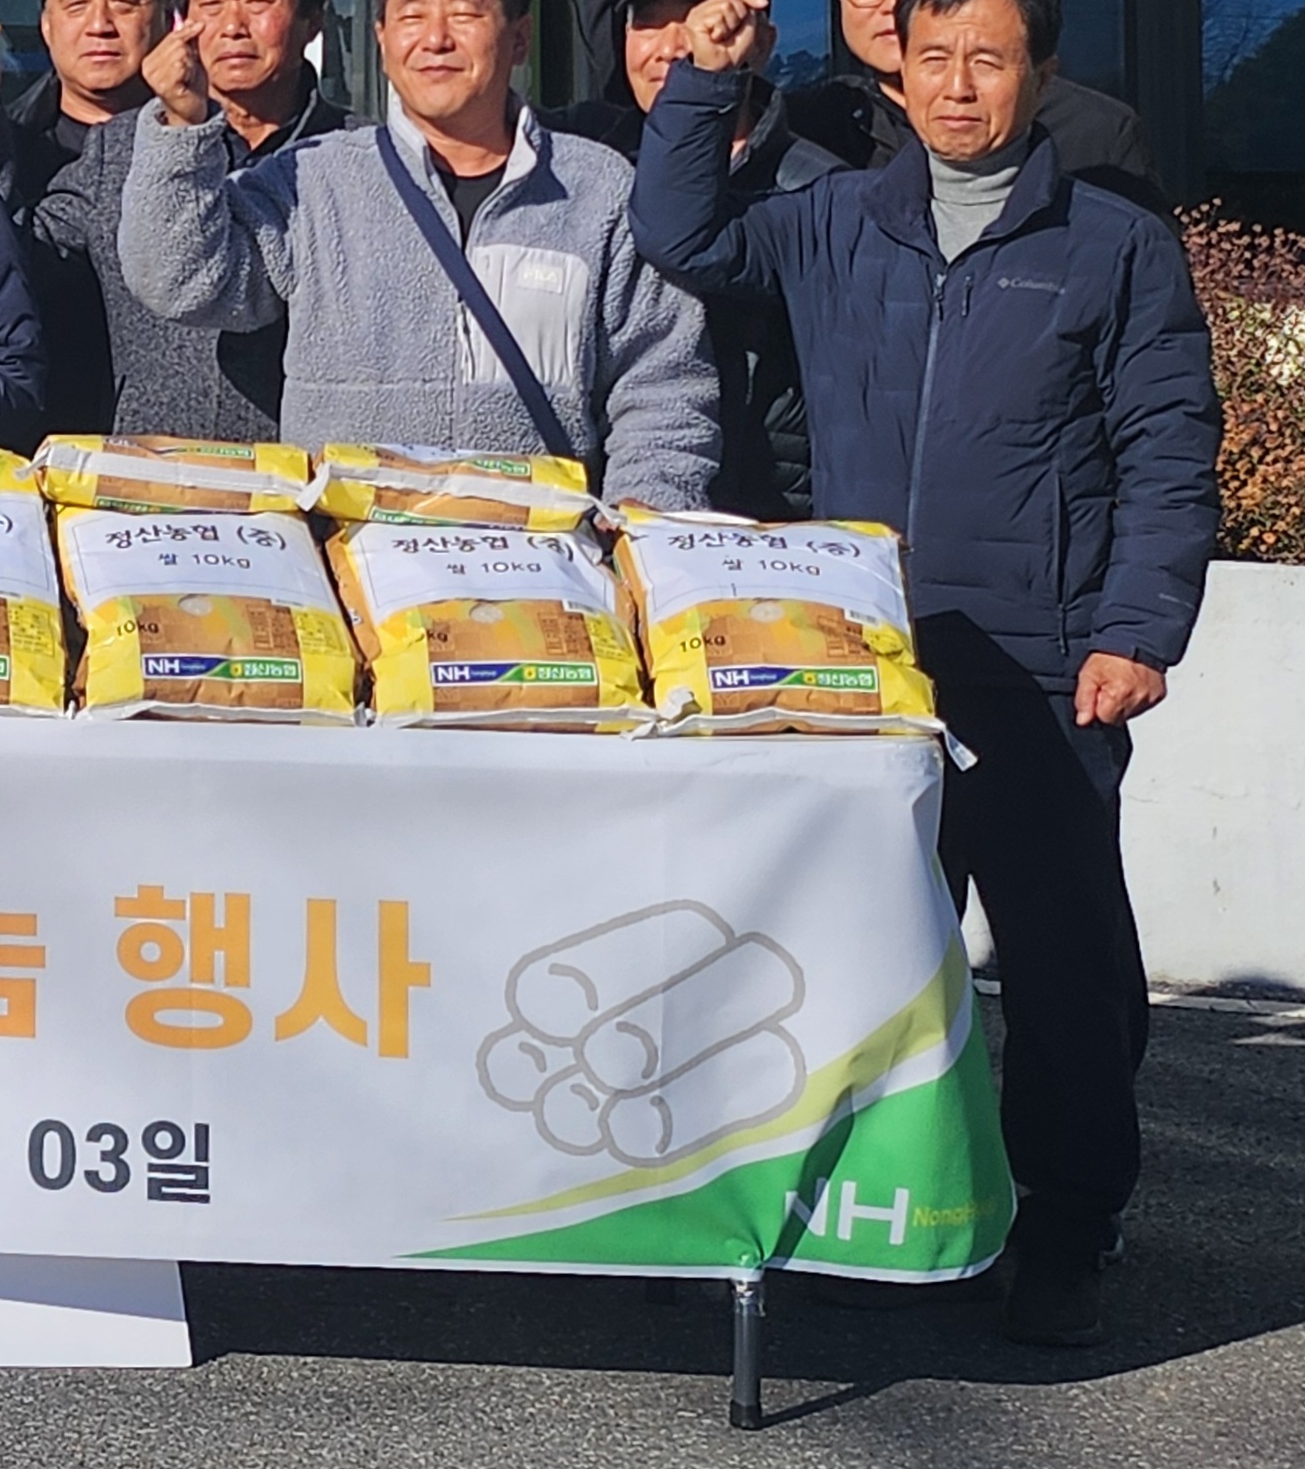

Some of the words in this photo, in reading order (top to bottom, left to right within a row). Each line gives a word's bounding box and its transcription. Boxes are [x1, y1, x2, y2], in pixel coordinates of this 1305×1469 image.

[105, 524, 220, 549] 정산농협
[392, 536, 509, 553] 정산농협
[667, 533, 788, 550] 정산농협
[192, 553, 251, 569] 10kg
[481, 562, 542, 573] 10kg
[758, 560, 821, 576] 10kg
[117, 619, 159, 637] 10kg
[680, 635, 726, 652] 10kg
[147, 659, 180, 674] NH
[437, 666, 471, 681] NH
[714, 670, 750, 686] NH
[114, 884, 432, 1060] 행사
[27, 1118, 212, 1204] 03일
[784, 1176, 909, 1245] NH
